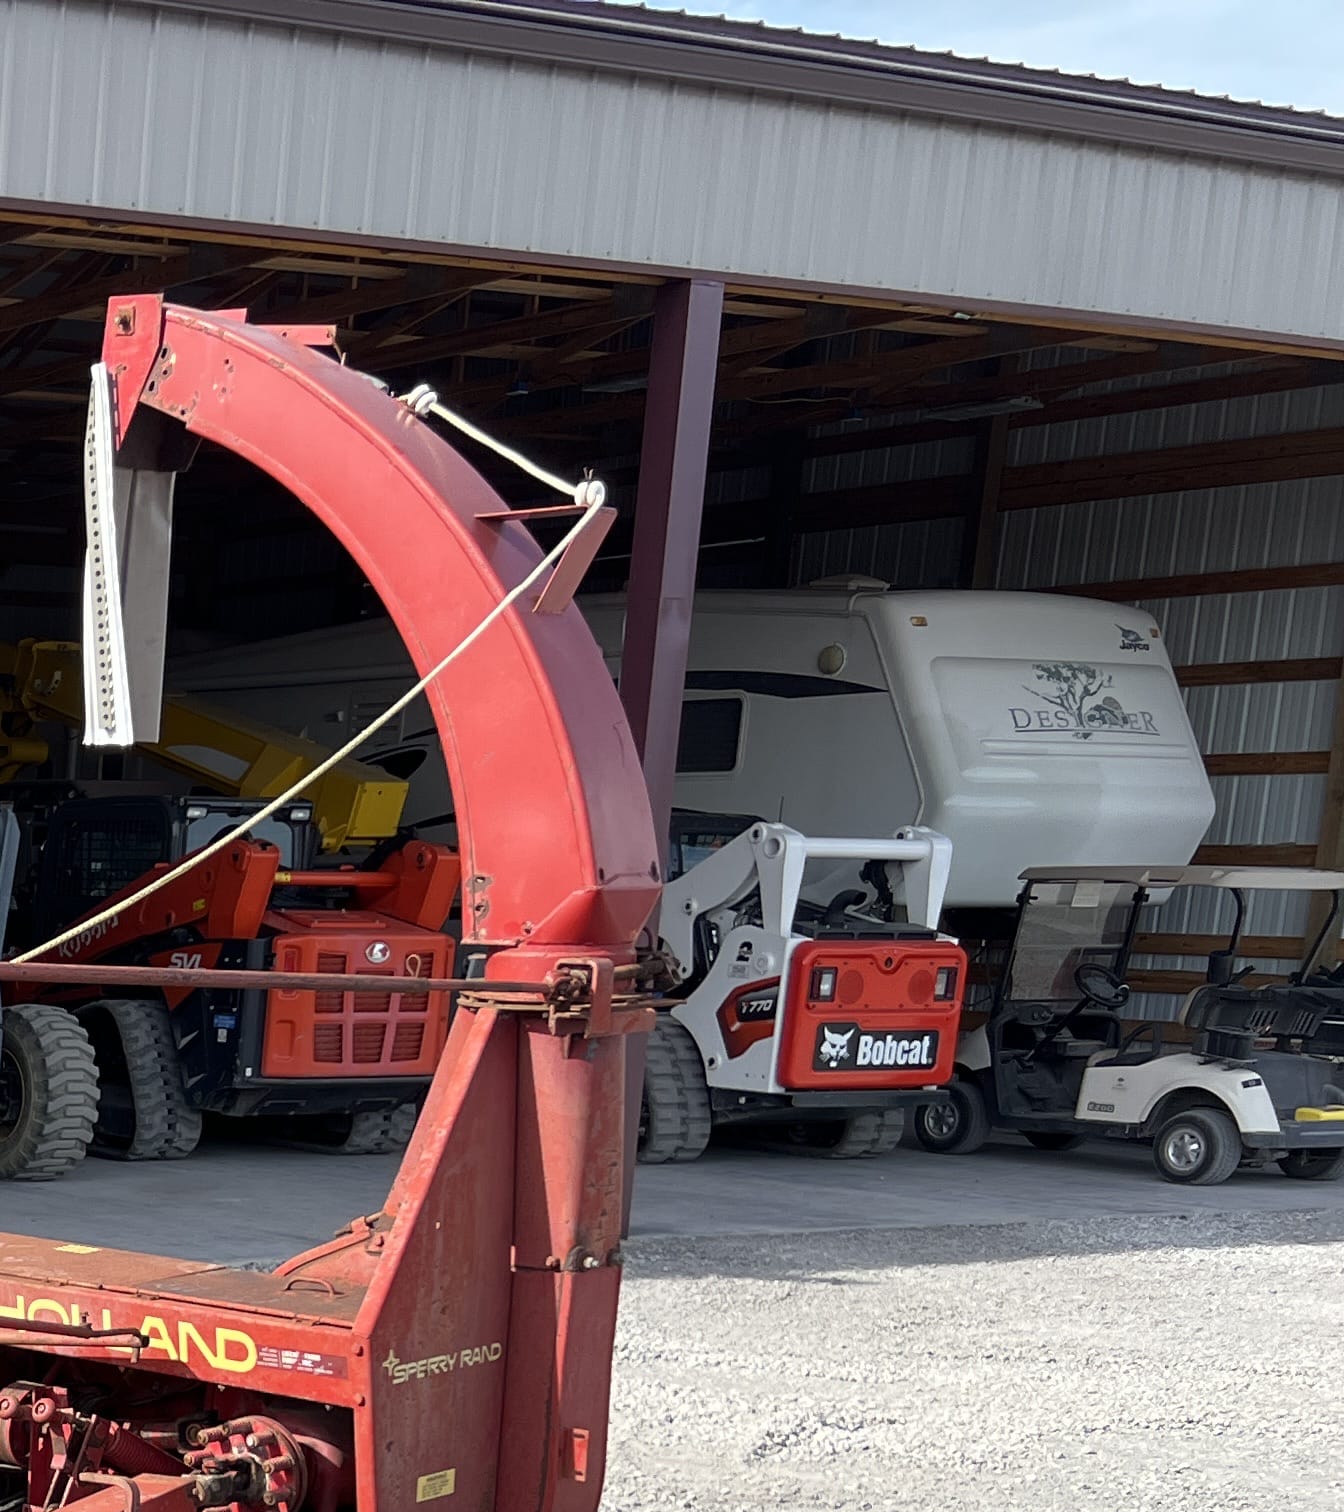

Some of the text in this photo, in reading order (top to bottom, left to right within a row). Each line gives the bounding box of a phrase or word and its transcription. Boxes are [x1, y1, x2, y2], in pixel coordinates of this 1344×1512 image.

[1119, 640, 1150, 652] Jayco
[1008, 707, 1159, 732] DESIGNER
[856, 1035, 930, 1066] Bobcat
[392, 1342, 503, 1385] SPERRY RAND
